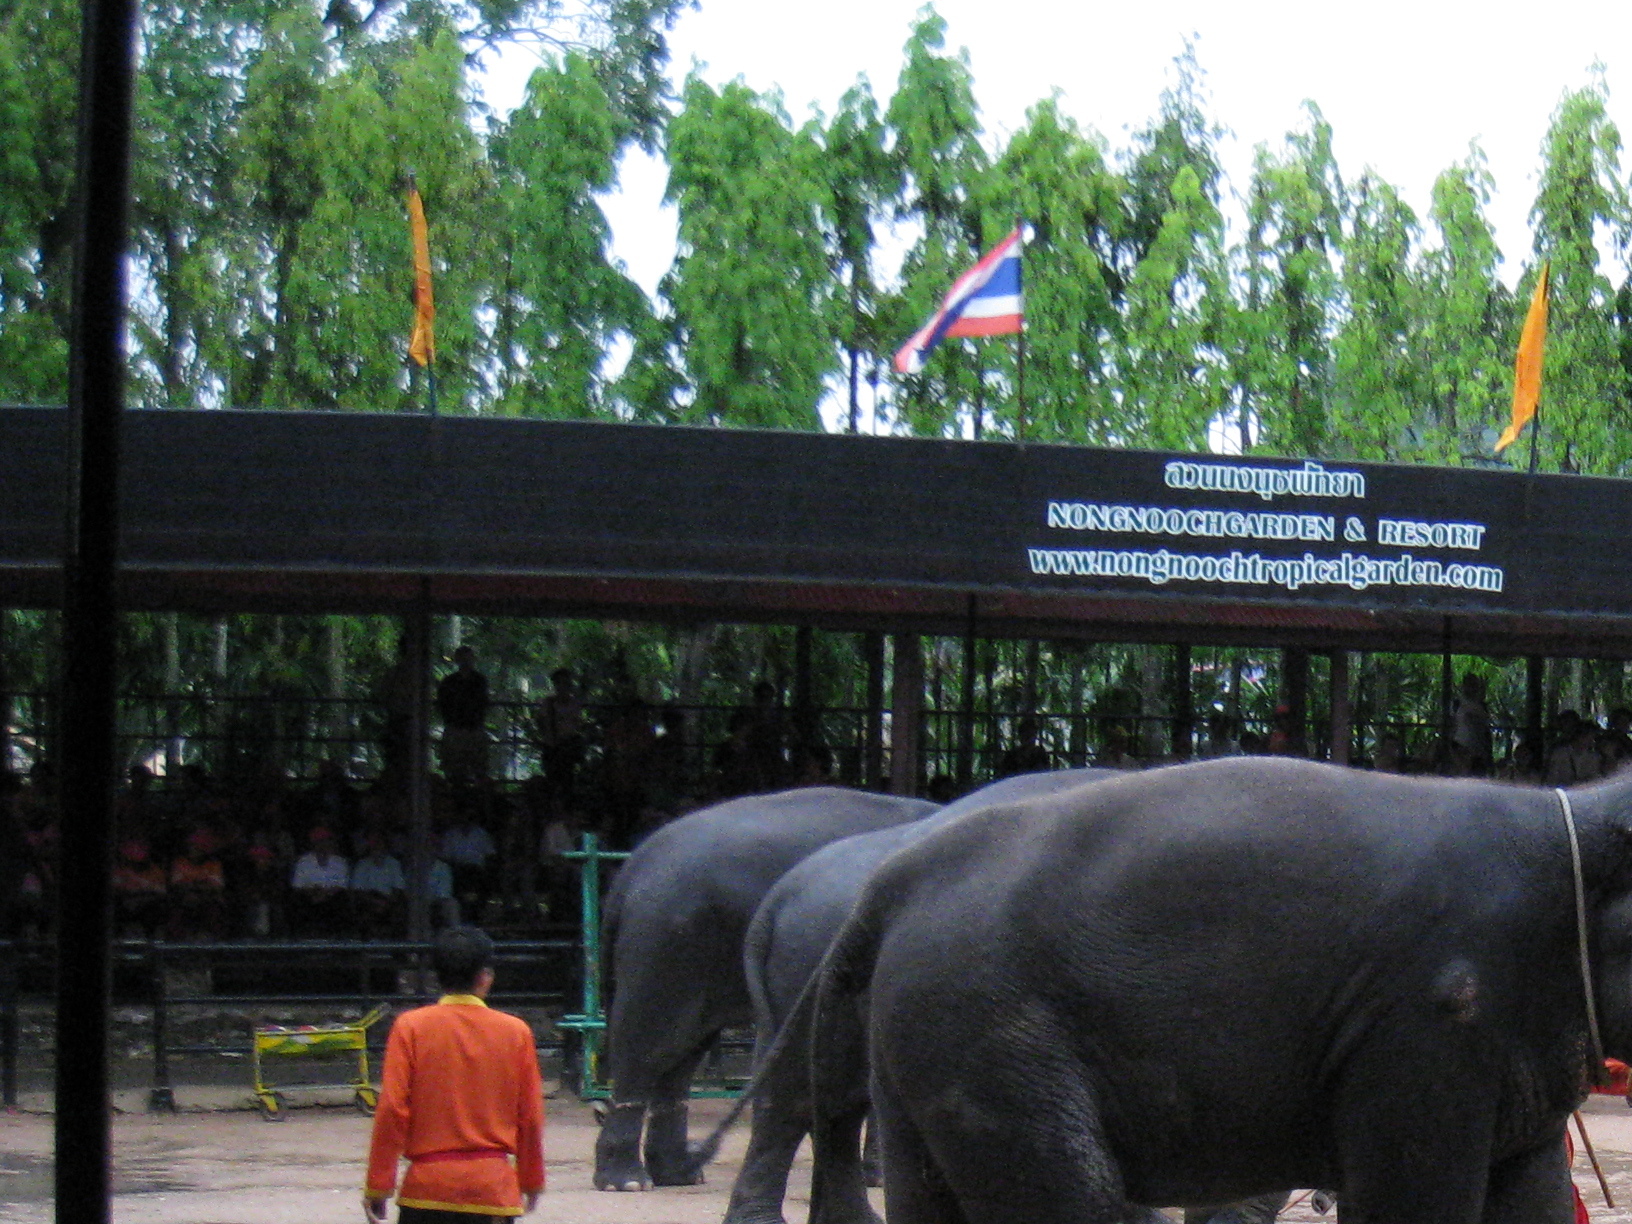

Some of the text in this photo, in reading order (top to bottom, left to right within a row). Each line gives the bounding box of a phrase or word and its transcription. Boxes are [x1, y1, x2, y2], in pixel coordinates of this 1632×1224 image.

[1164, 460, 1365, 500] สวนนงนุชพัทยา
[1047, 502, 1485, 549] NONGNOOCHGARDEN & RESORT
[1027, 547, 1503, 592] www.nongnoochtropicalgarden.com
